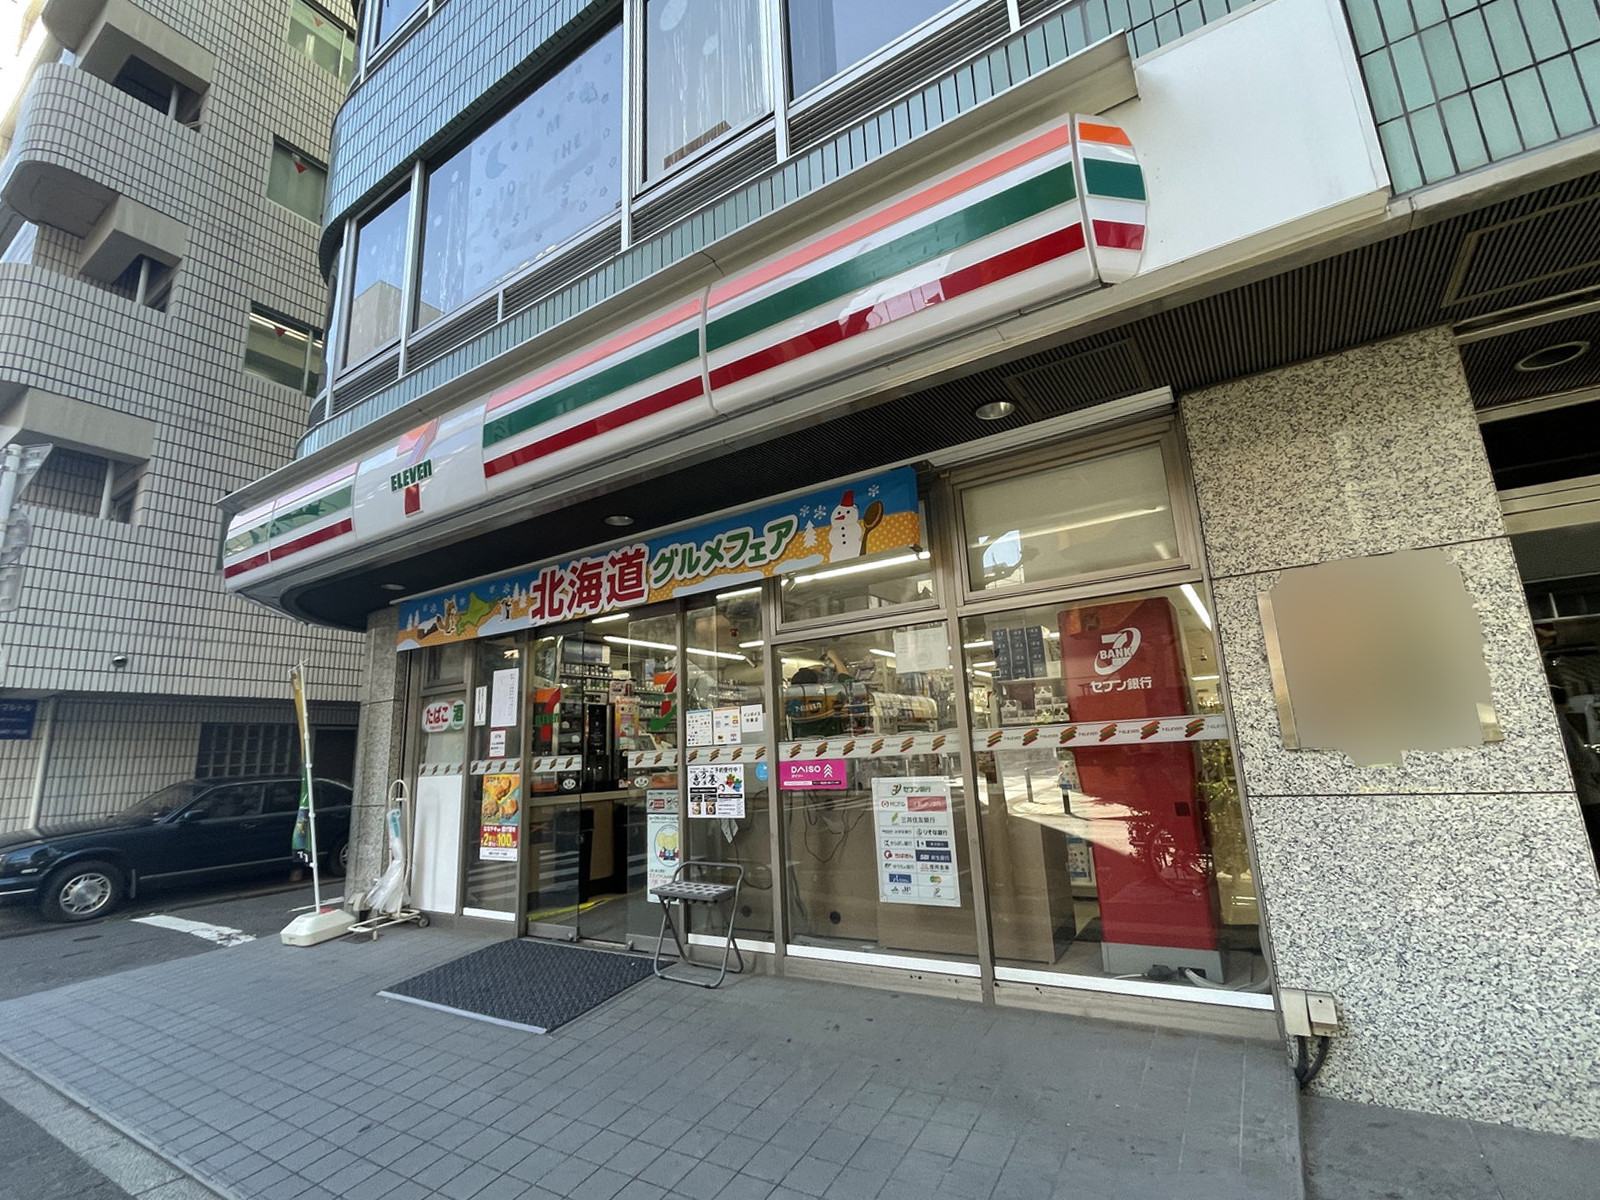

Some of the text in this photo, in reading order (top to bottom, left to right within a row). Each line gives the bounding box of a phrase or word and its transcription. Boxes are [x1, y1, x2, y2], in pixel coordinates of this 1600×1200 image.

[1099, 647, 1133, 660] BANK
[1090, 676, 1154, 694] セブン銀行
[425, 705, 448, 725] たばこ
[452, 704, 464, 722] 酒
[791, 764, 821, 774] DAISO
